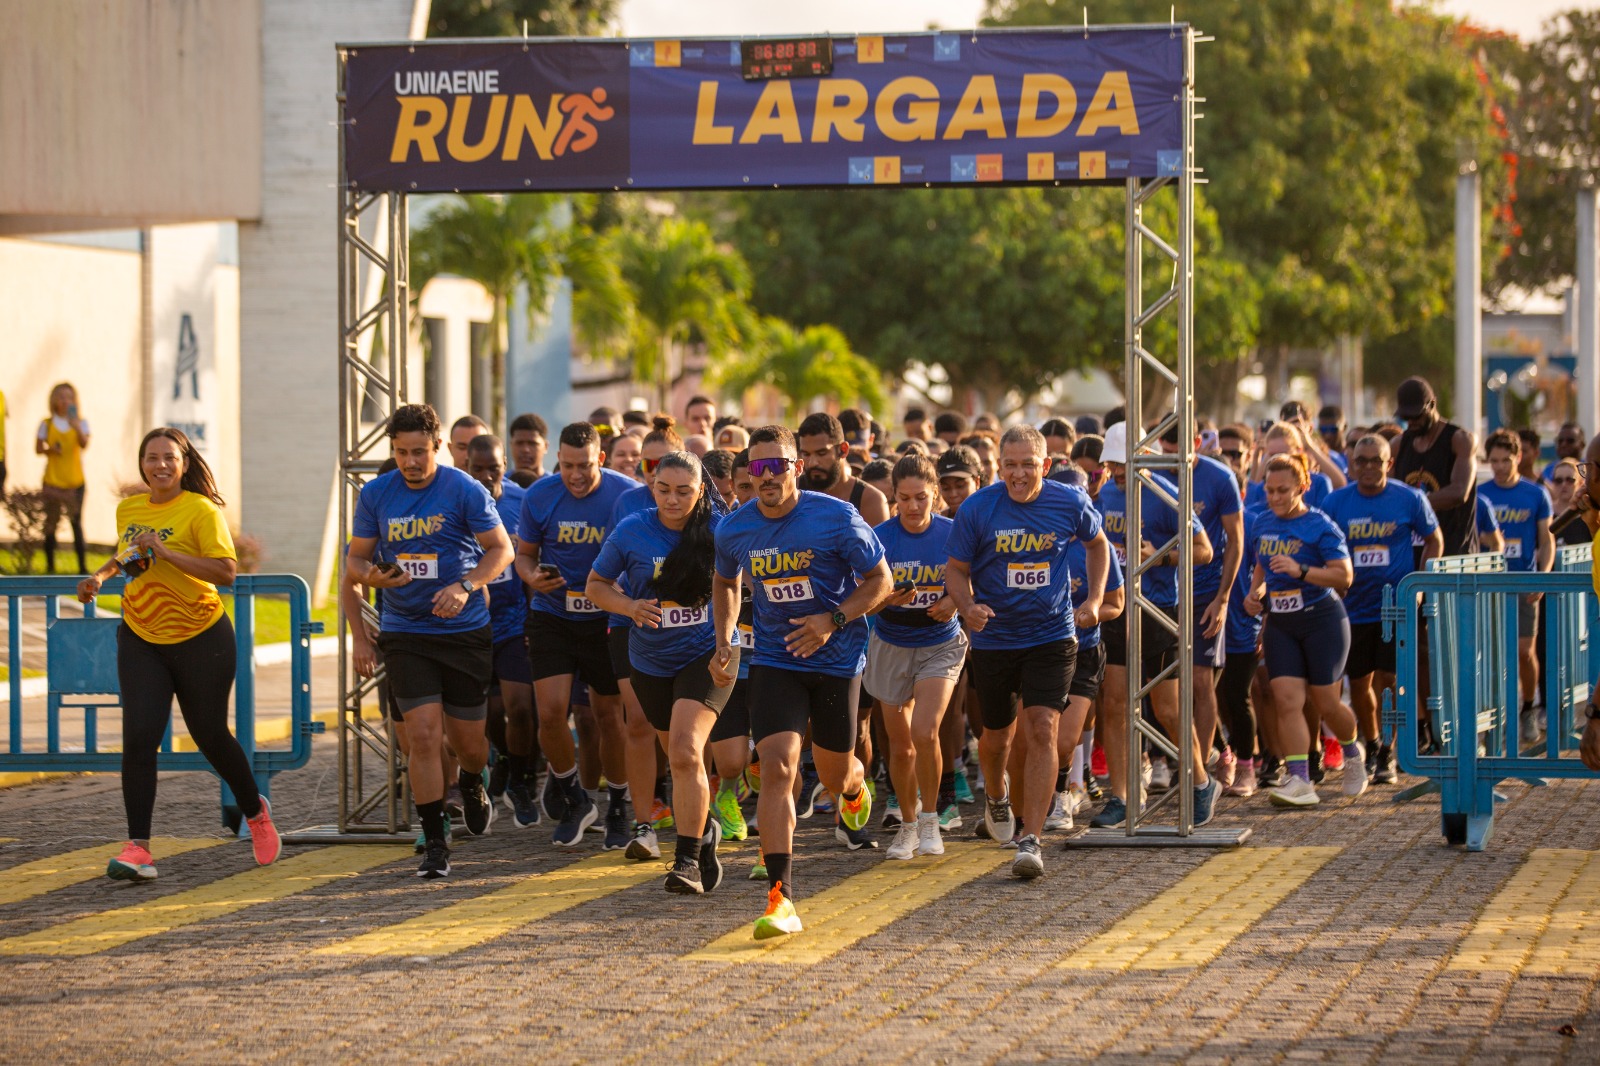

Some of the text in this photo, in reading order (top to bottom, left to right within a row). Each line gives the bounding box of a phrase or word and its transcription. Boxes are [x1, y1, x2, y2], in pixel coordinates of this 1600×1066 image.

[394, 69, 499, 95] UNIAENE
[692, 70, 1141, 146] LARGADA
[389, 93, 566, 163] RUN
[387, 516, 432, 542] RUN
[995, 528, 1025, 537] UNIAENE
[1105, 515, 1127, 533] RU
[1348, 522, 1385, 540] RUN
[557, 526, 606, 544] RUN
[995, 533, 1044, 553] RUN
[748, 547, 780, 558] UNIAENE
[1259, 540, 1290, 556] RUN
[750, 552, 799, 577] RUN
[891, 560, 921, 569] UNIAENE
[1360, 552, 1384, 564] 073
[403, 561, 429, 577] 119
[893, 564, 940, 584] RUN
[1014, 571, 1046, 586] 066
[771, 583, 806, 601] 018
[1275, 597, 1299, 610] 092
[669, 607, 703, 625] 059
